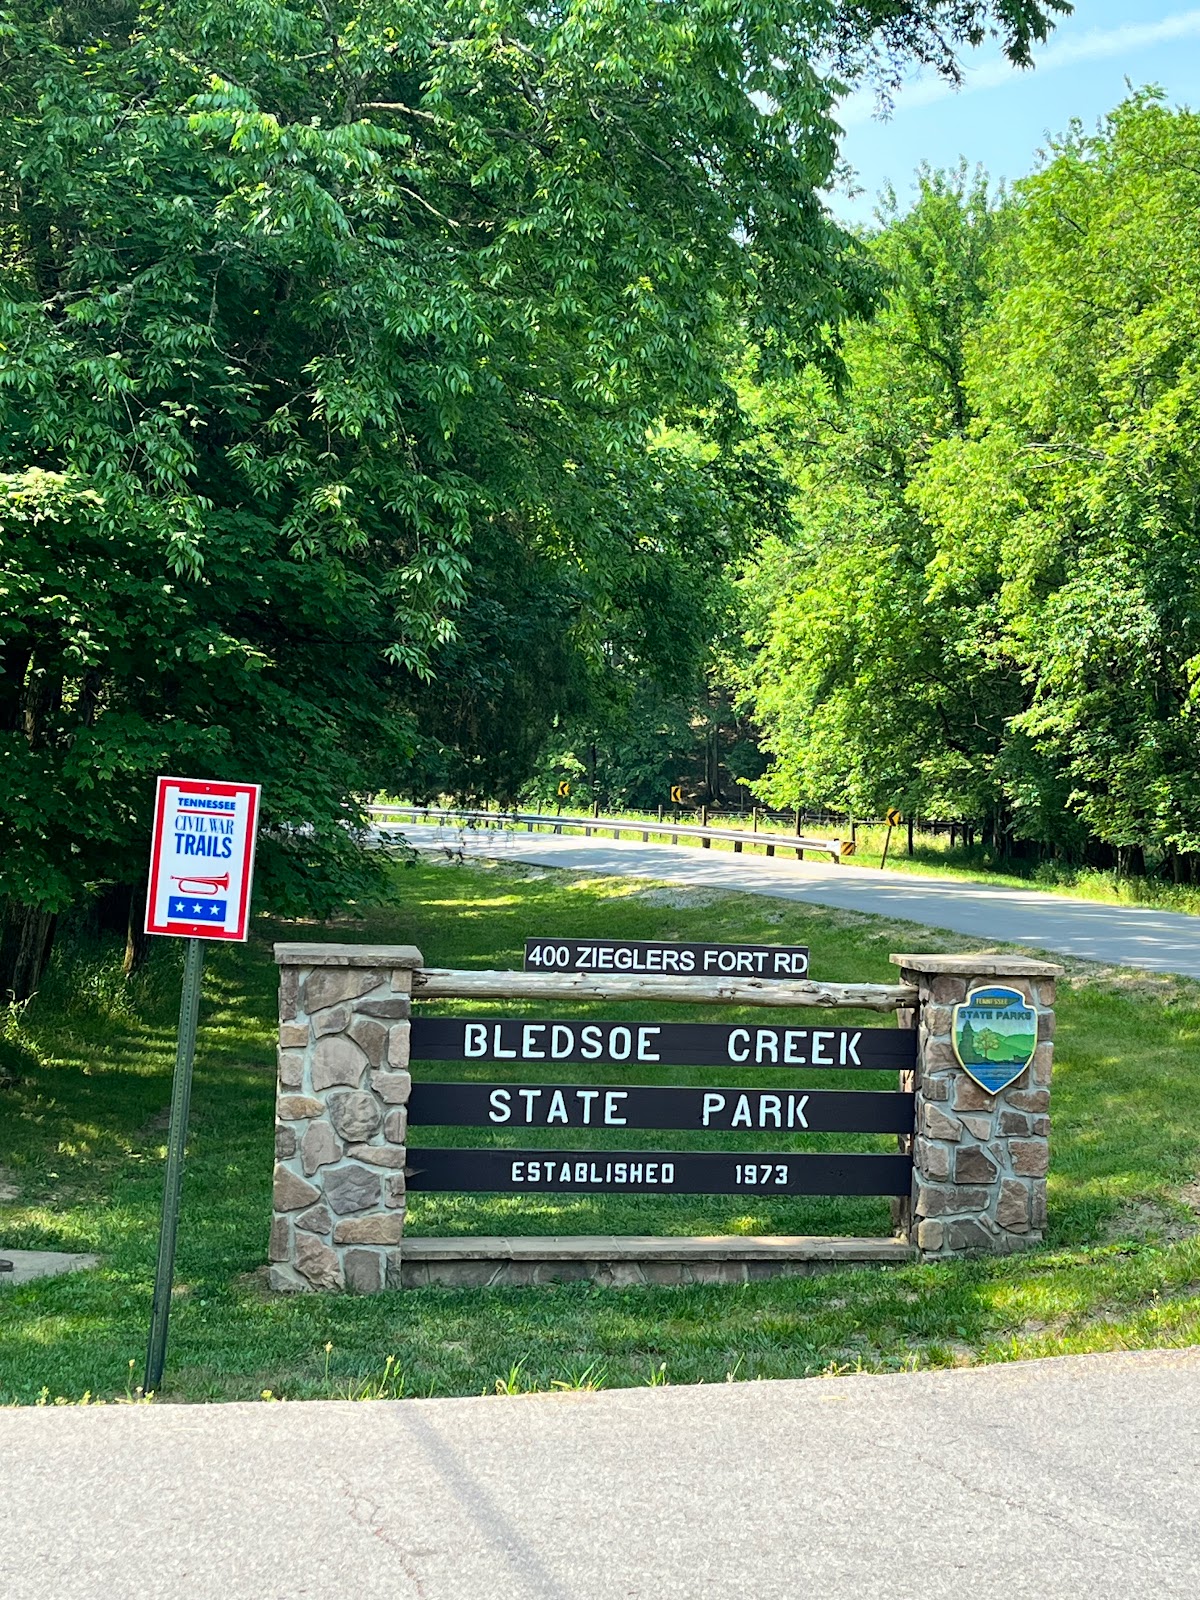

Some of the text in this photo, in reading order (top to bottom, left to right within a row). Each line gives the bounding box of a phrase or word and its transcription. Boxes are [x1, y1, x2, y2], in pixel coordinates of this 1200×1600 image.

[178, 797, 236, 810] TENNESSEE
[175, 815, 234, 835] CIVIL WAR
[174, 832, 232, 858] TRAILS
[528, 945, 808, 974] 400 ZIEGLERS FORT RD
[959, 1010, 1031, 1020] STATE PARKS
[464, 1023, 862, 1066] BLEDSOE CREEK
[488, 1088, 810, 1129] STATE PARK
[511, 1161, 789, 1186] ESTABLISHED 1973
